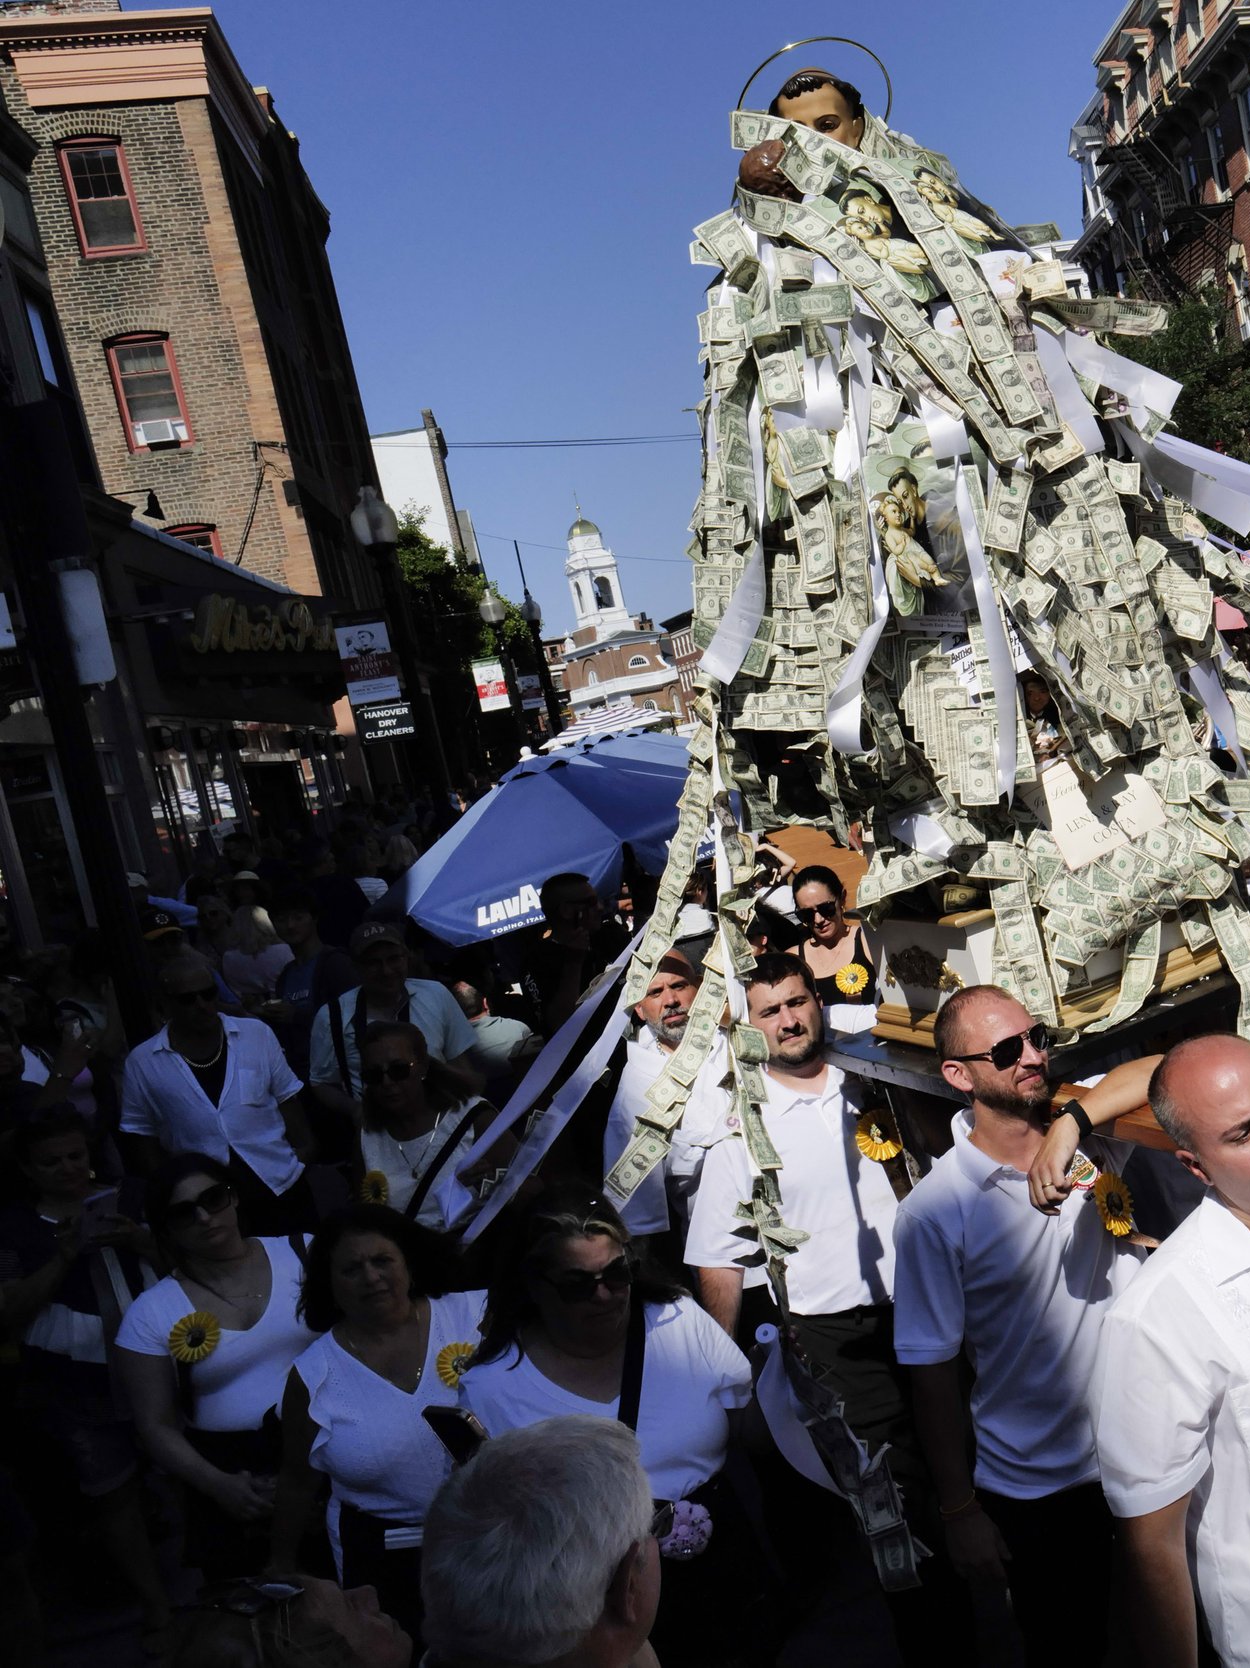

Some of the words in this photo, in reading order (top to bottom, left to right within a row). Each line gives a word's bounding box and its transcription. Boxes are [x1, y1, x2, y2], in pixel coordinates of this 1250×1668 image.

[191, 593, 287, 654] Mike's
[350, 659, 392, 672] ANTHONY'S
[363, 707, 409, 719] HANOVER
[365, 726, 415, 739] CLEANERS
[378, 718, 397, 728] DRY
[1101, 804, 1113, 815] &
[1111, 790, 1137, 809] RAY
[1092, 816, 1137, 845] COSTA
[477, 884, 542, 927] LAVA
